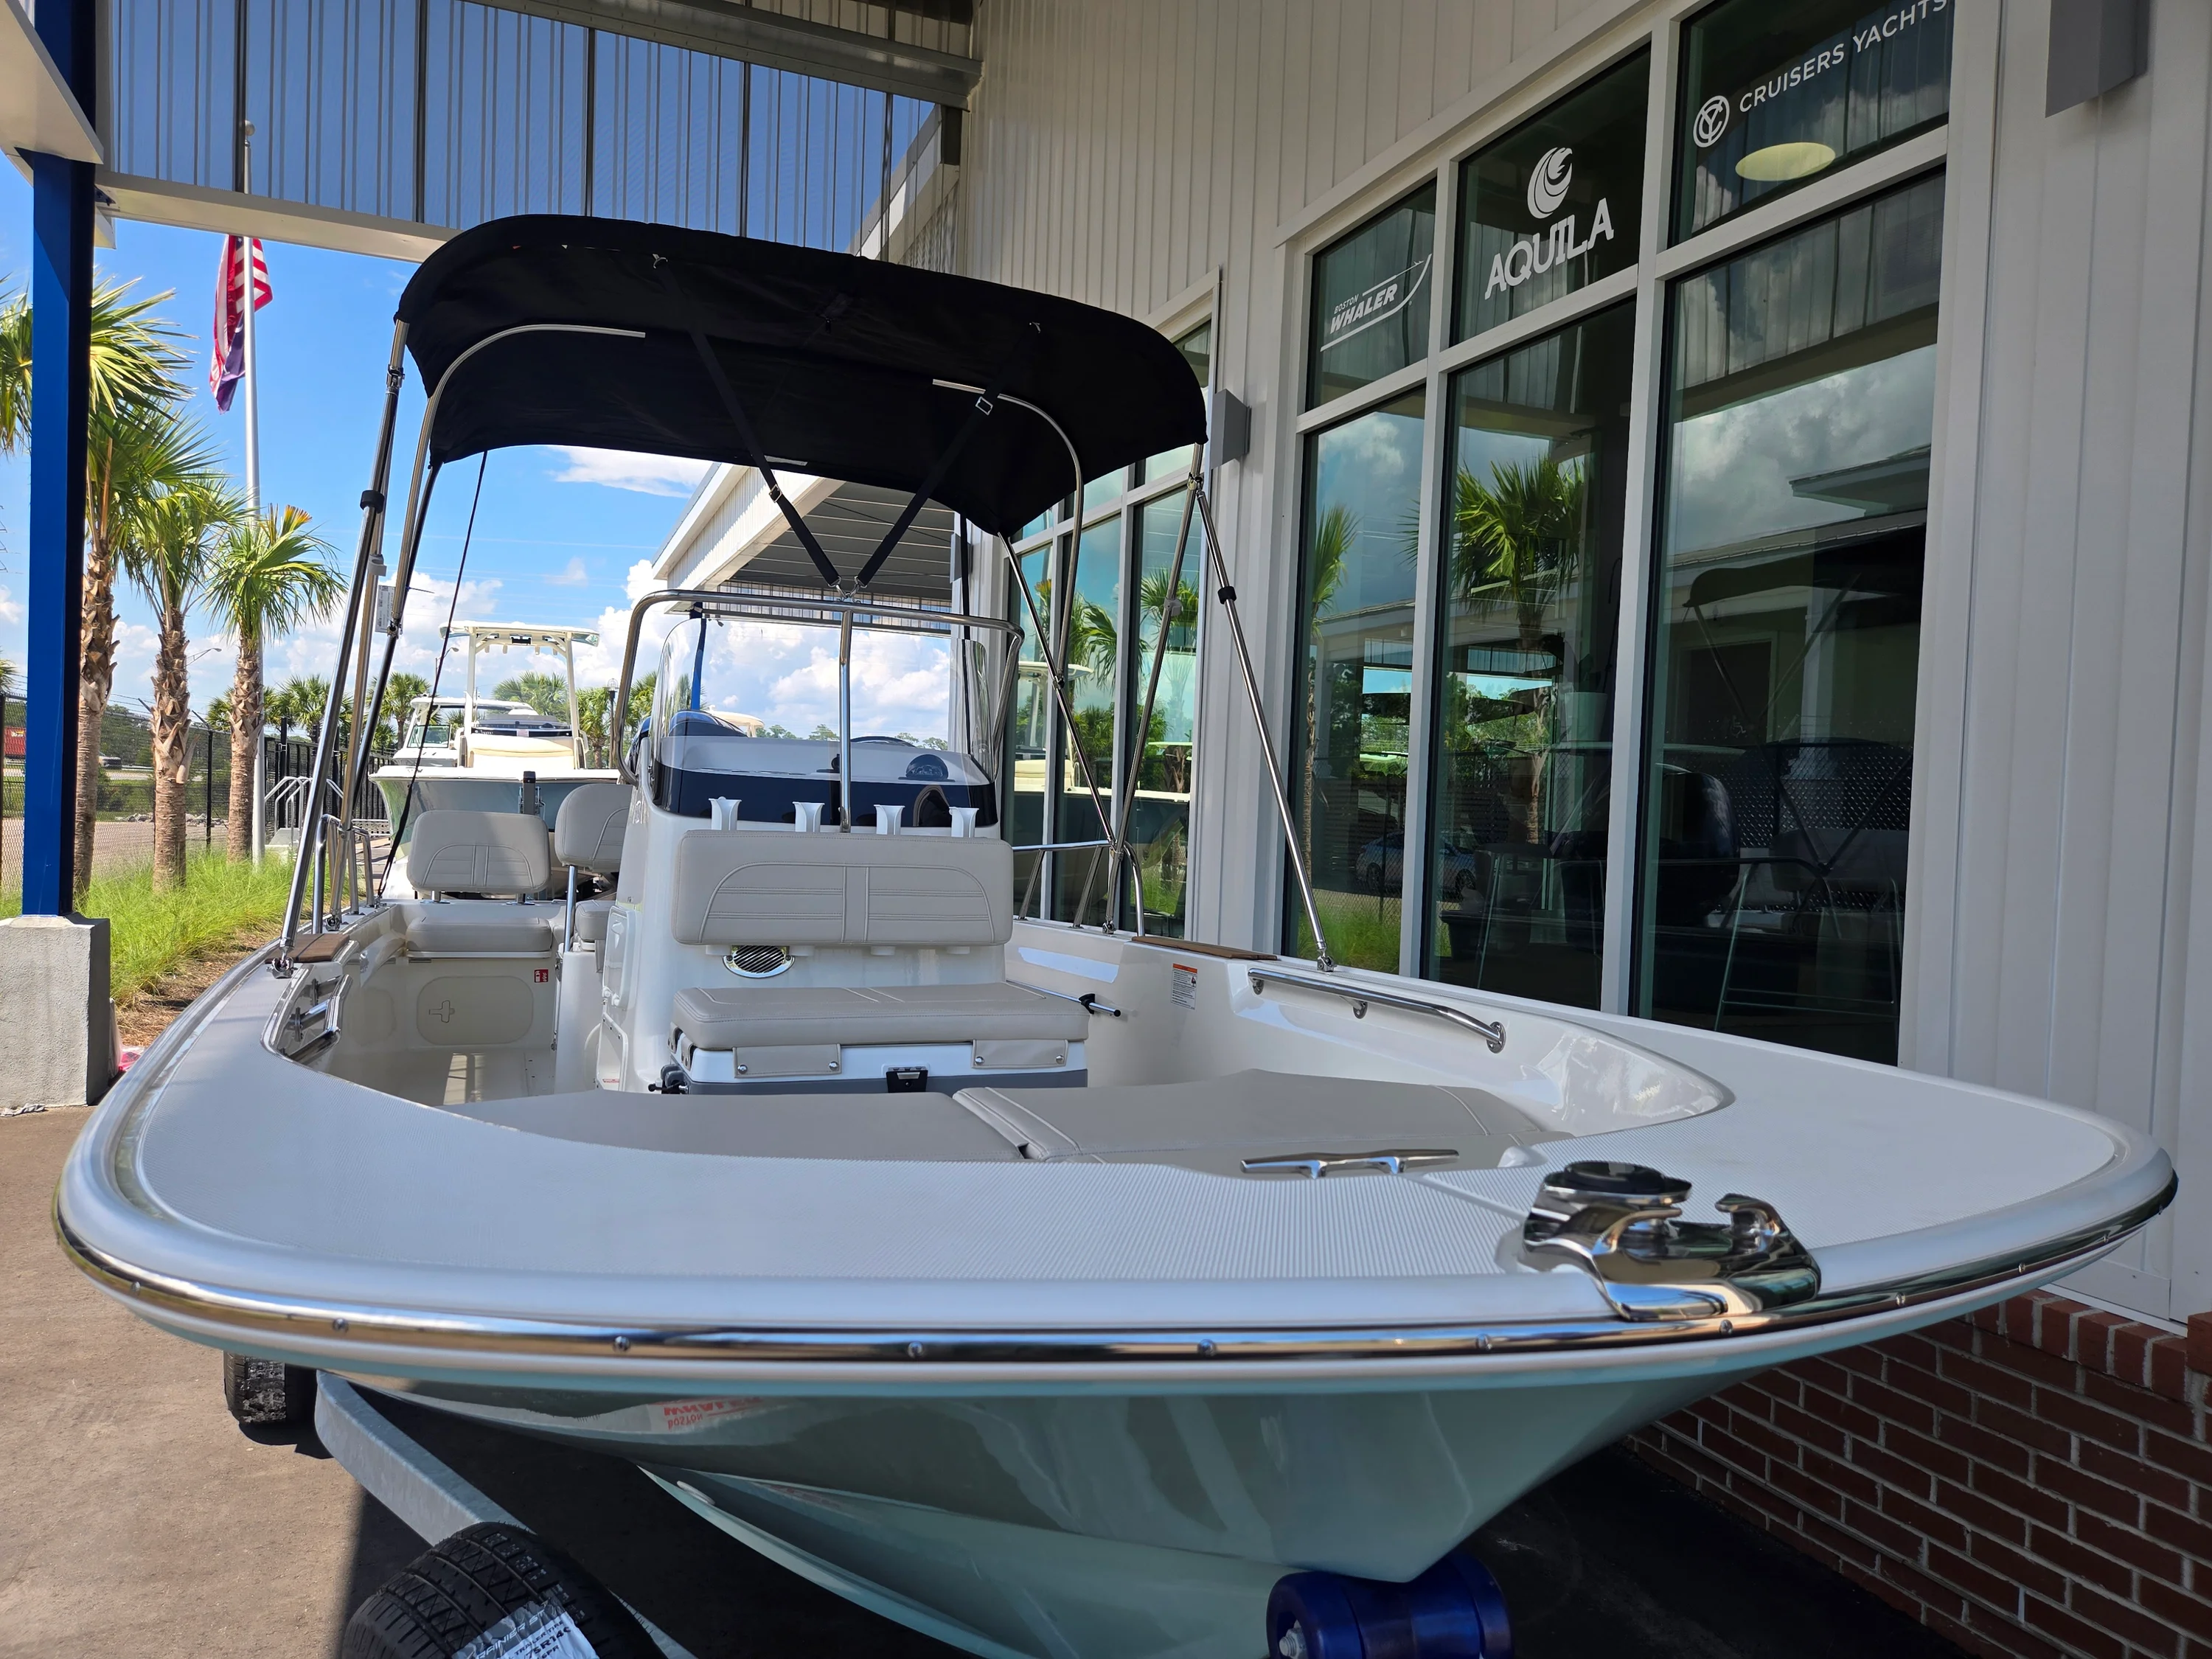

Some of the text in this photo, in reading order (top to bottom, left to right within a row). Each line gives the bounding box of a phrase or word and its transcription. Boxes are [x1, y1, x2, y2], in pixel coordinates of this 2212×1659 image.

[1739, 0, 1947, 114] CRUISERS YACHTS
[1484, 198, 1615, 300] AQUILA
[1329, 283, 1398, 335] WHALER
[1334, 293, 1359, 315] BOSTON
[476, 1608, 546, 1659] RAINIER ST
